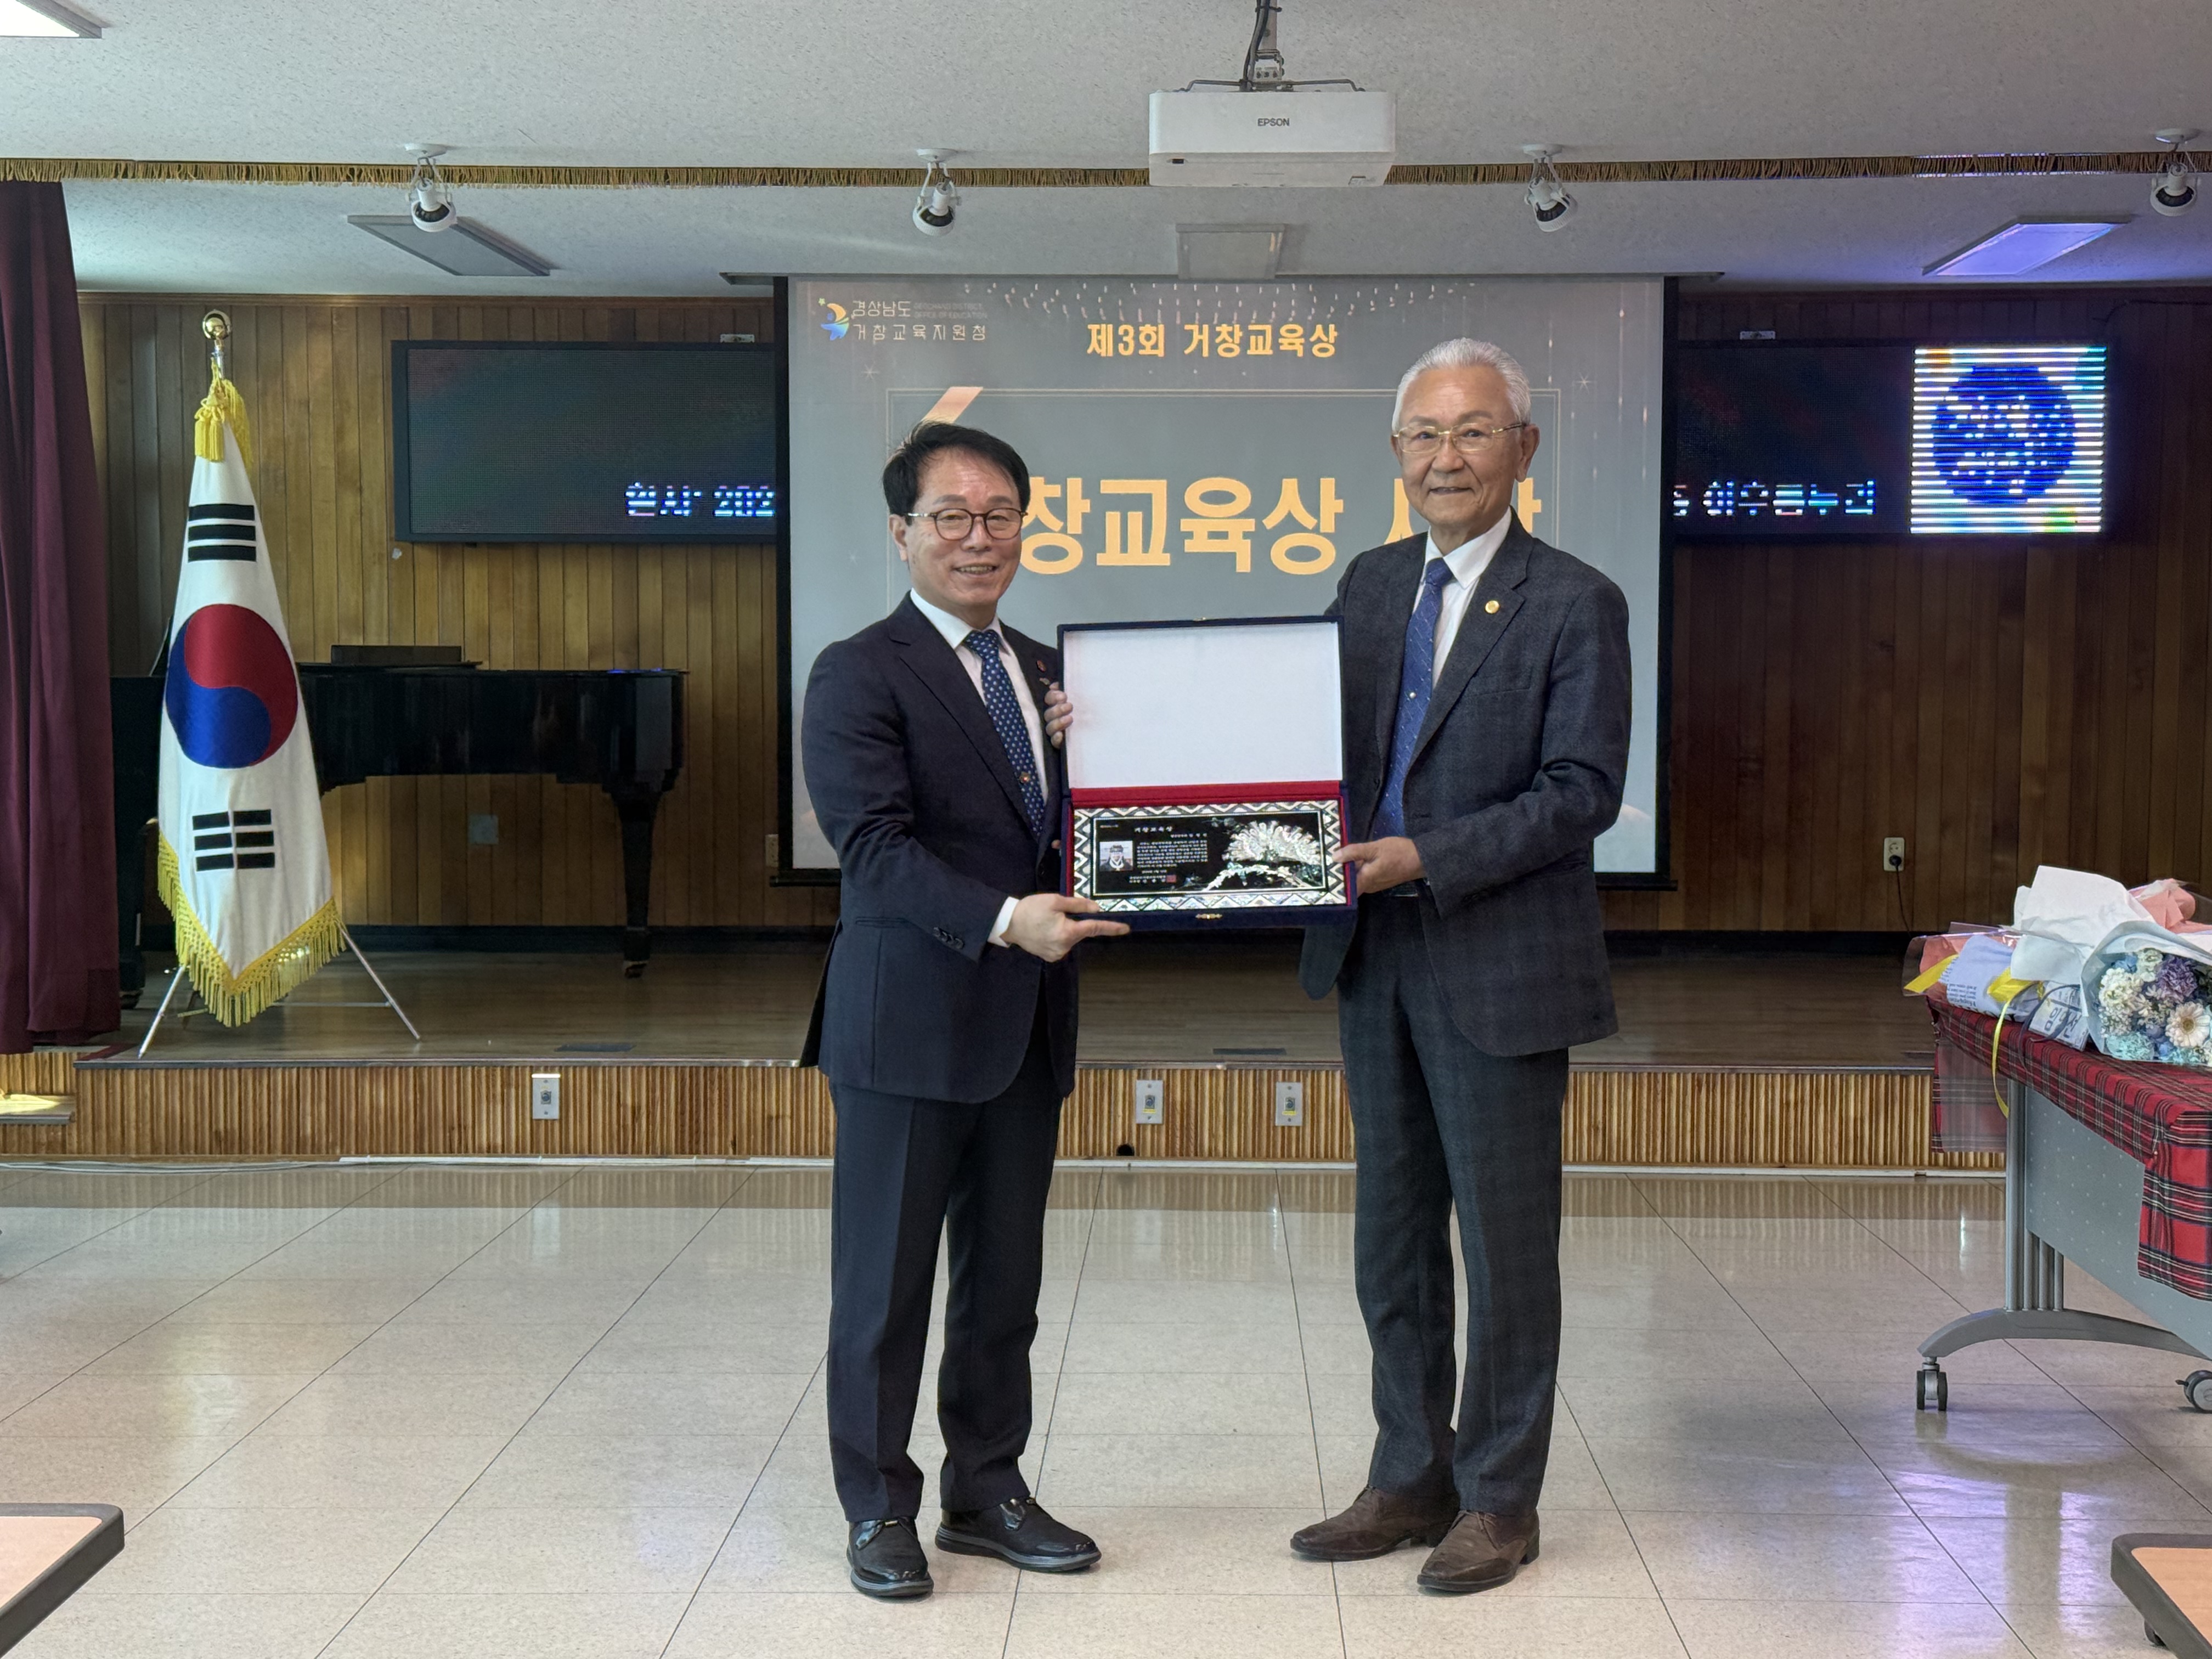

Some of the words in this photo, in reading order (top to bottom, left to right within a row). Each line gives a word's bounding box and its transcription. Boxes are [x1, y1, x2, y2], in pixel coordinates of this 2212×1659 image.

[1257, 117, 1290, 127] EPSON
[852, 301, 911, 317] 경상남도
[853, 324, 986, 341] 거창교육지원청
[1086, 324, 1165, 358] 제3회
[1183, 324, 1338, 358] 거창교육상
